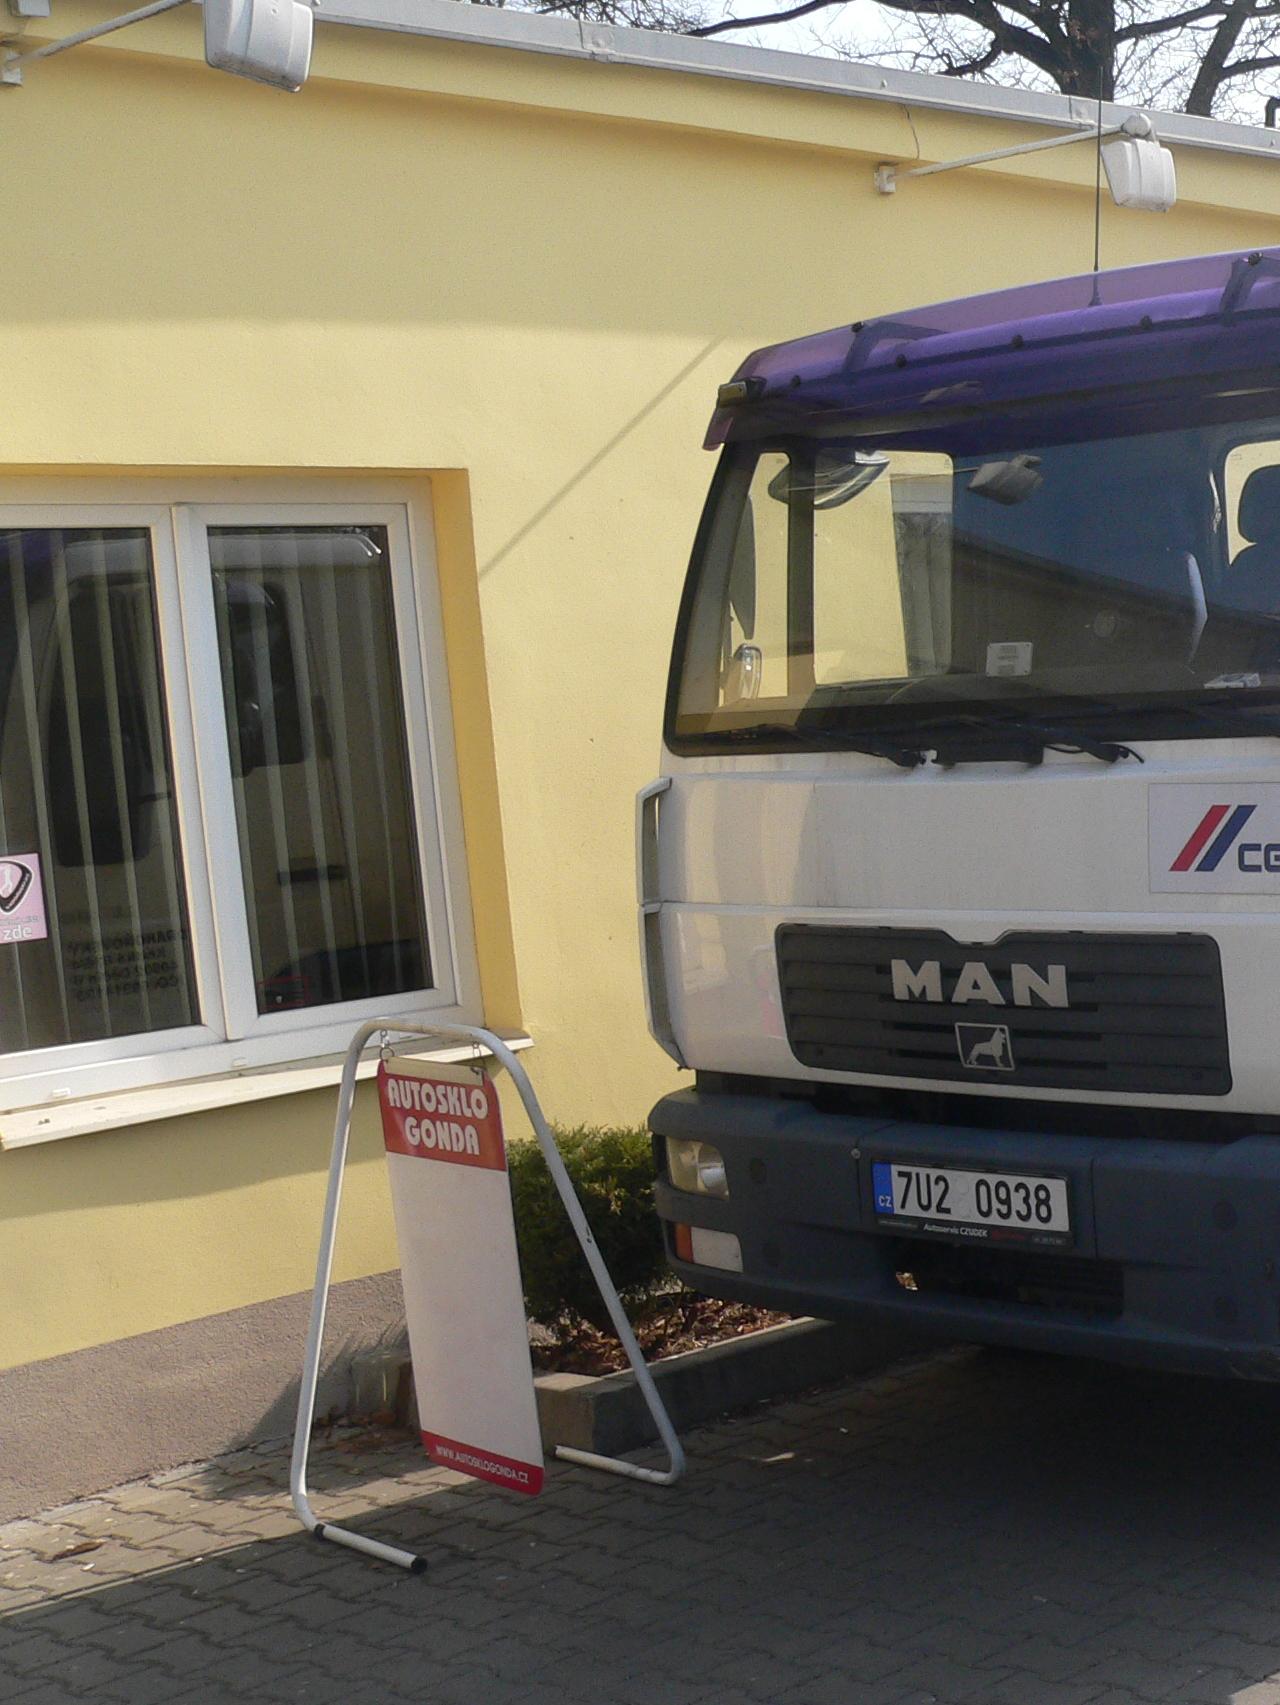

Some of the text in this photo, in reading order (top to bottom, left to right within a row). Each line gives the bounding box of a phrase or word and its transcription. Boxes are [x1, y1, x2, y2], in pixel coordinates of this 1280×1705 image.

[3, 925, 33, 941] zde
[891, 959, 1069, 1008] MAN
[387, 1078, 488, 1119] AUTOSKLO
[404, 1116, 480, 1155] GONDA
[879, 1195, 892, 1208] CZ
[897, 1171, 1052, 1223] 7U2 0938
